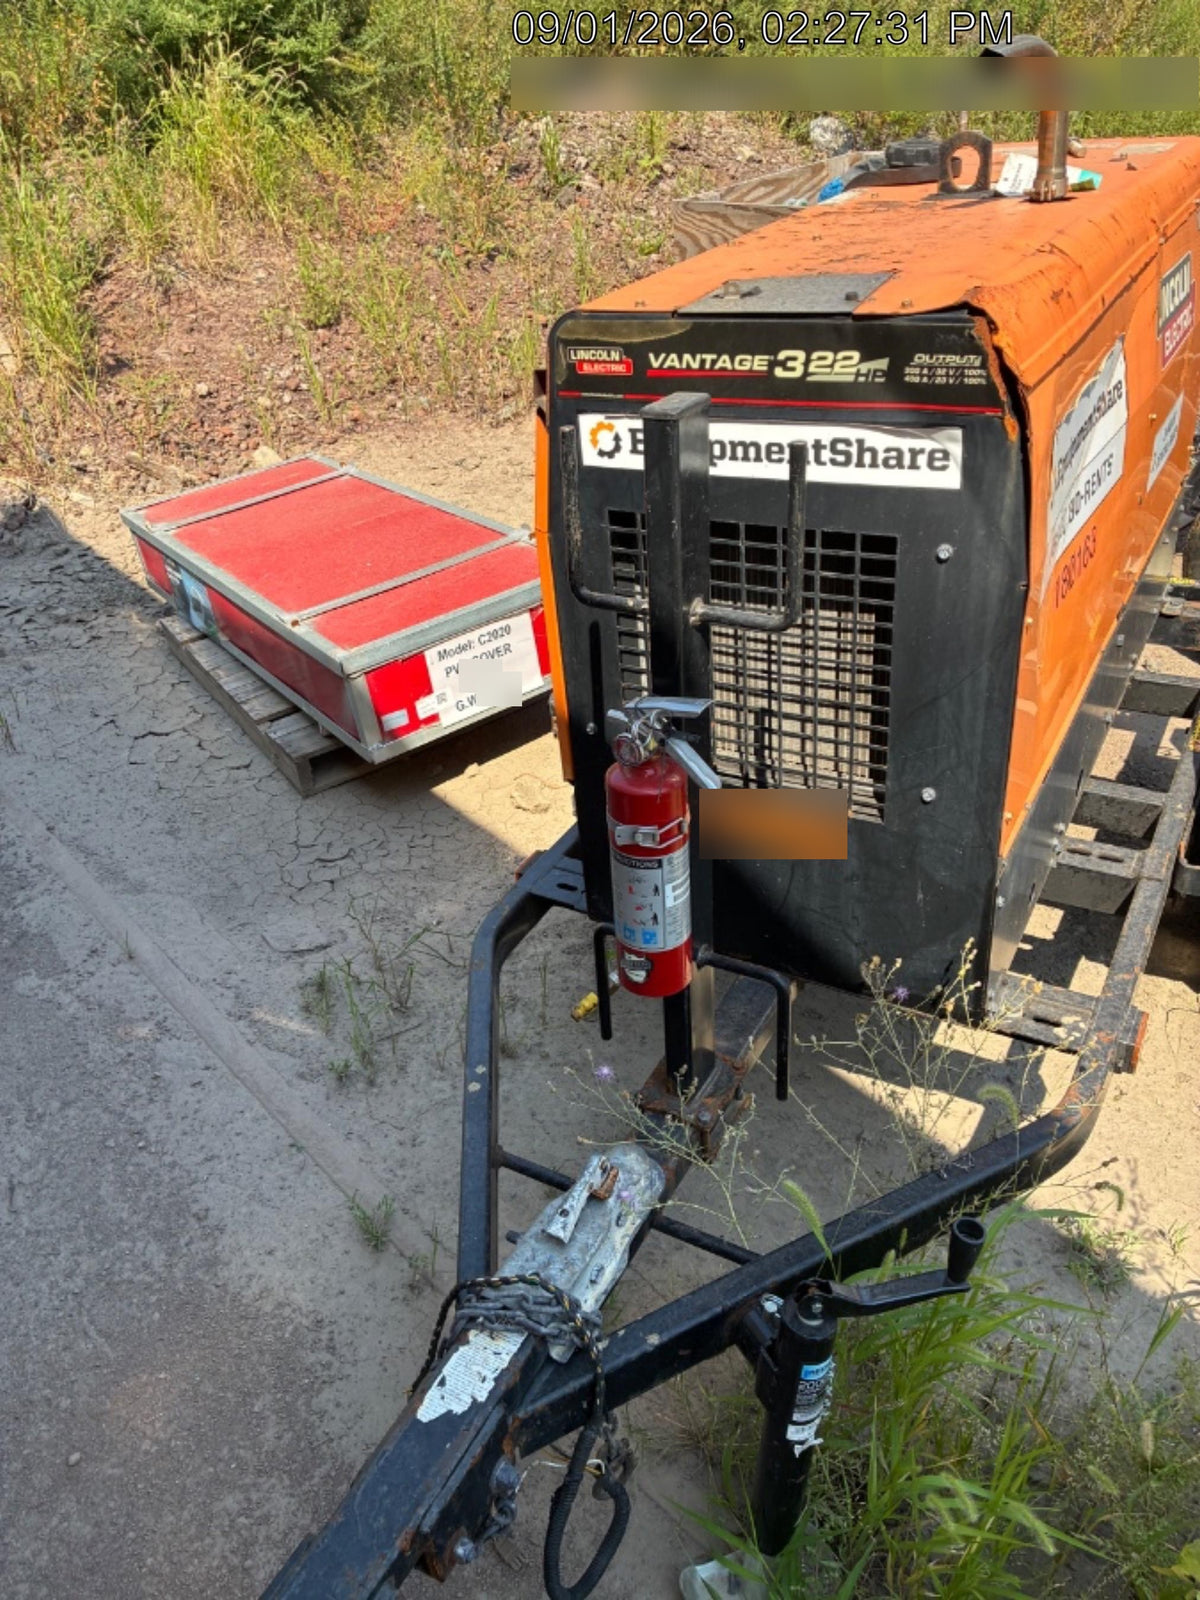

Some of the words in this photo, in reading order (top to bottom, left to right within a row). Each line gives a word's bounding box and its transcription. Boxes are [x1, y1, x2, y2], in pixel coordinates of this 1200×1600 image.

[570, 349, 620, 361] LINCOLN
[649, 352, 769, 371] VANTAGE
[914, 353, 977, 365] OUTPUT
[582, 362, 627, 373] ELECTRIC
[629, 427, 952, 472] EpmetShare
[437, 640, 475, 662] Model:
[478, 624, 511, 645] C2020
